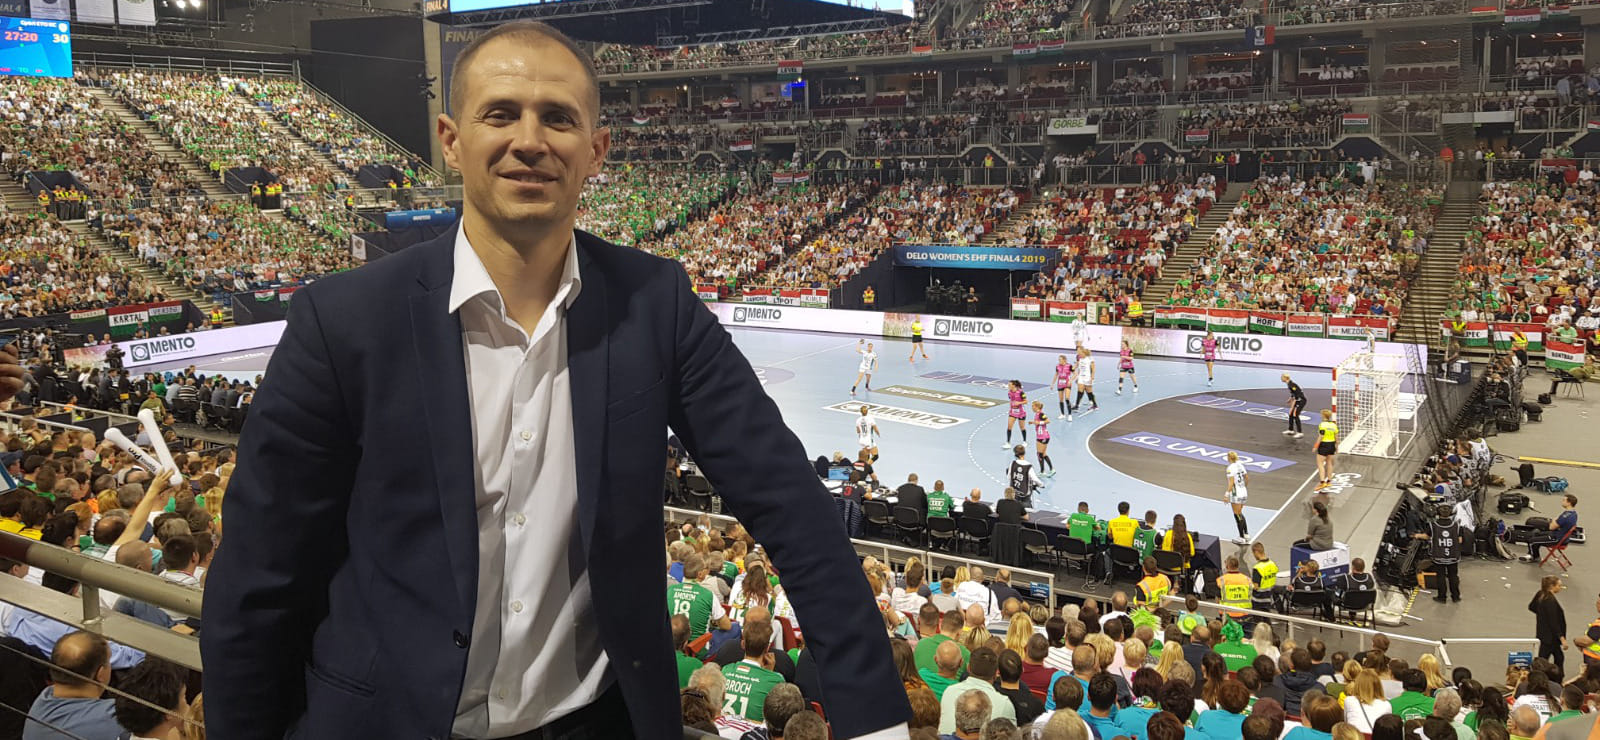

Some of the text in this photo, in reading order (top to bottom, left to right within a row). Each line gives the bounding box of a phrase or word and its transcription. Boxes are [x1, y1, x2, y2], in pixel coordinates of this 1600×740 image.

[5, 31, 38, 42] 27:20
[52, 33, 69, 44] 30
[906, 252, 928, 260] DELO
[929, 252, 970, 261] WOMEN'S
[971, 254, 988, 262] EHF
[1021, 255, 1046, 263] 2019
[113, 314, 144, 324] KARTAL
[1256, 317, 1277, 327] HORT
[1166, 442, 1272, 470] UNIQA
[1013, 471, 1024, 482] HB
[843, 486, 853, 496] 3
[1133, 538, 1147, 550] RH
[1438, 538, 1453, 547] HB
[1444, 547, 1450, 556] 5
[725, 679, 752, 695] BROCH
[721, 692, 749, 719] 31
